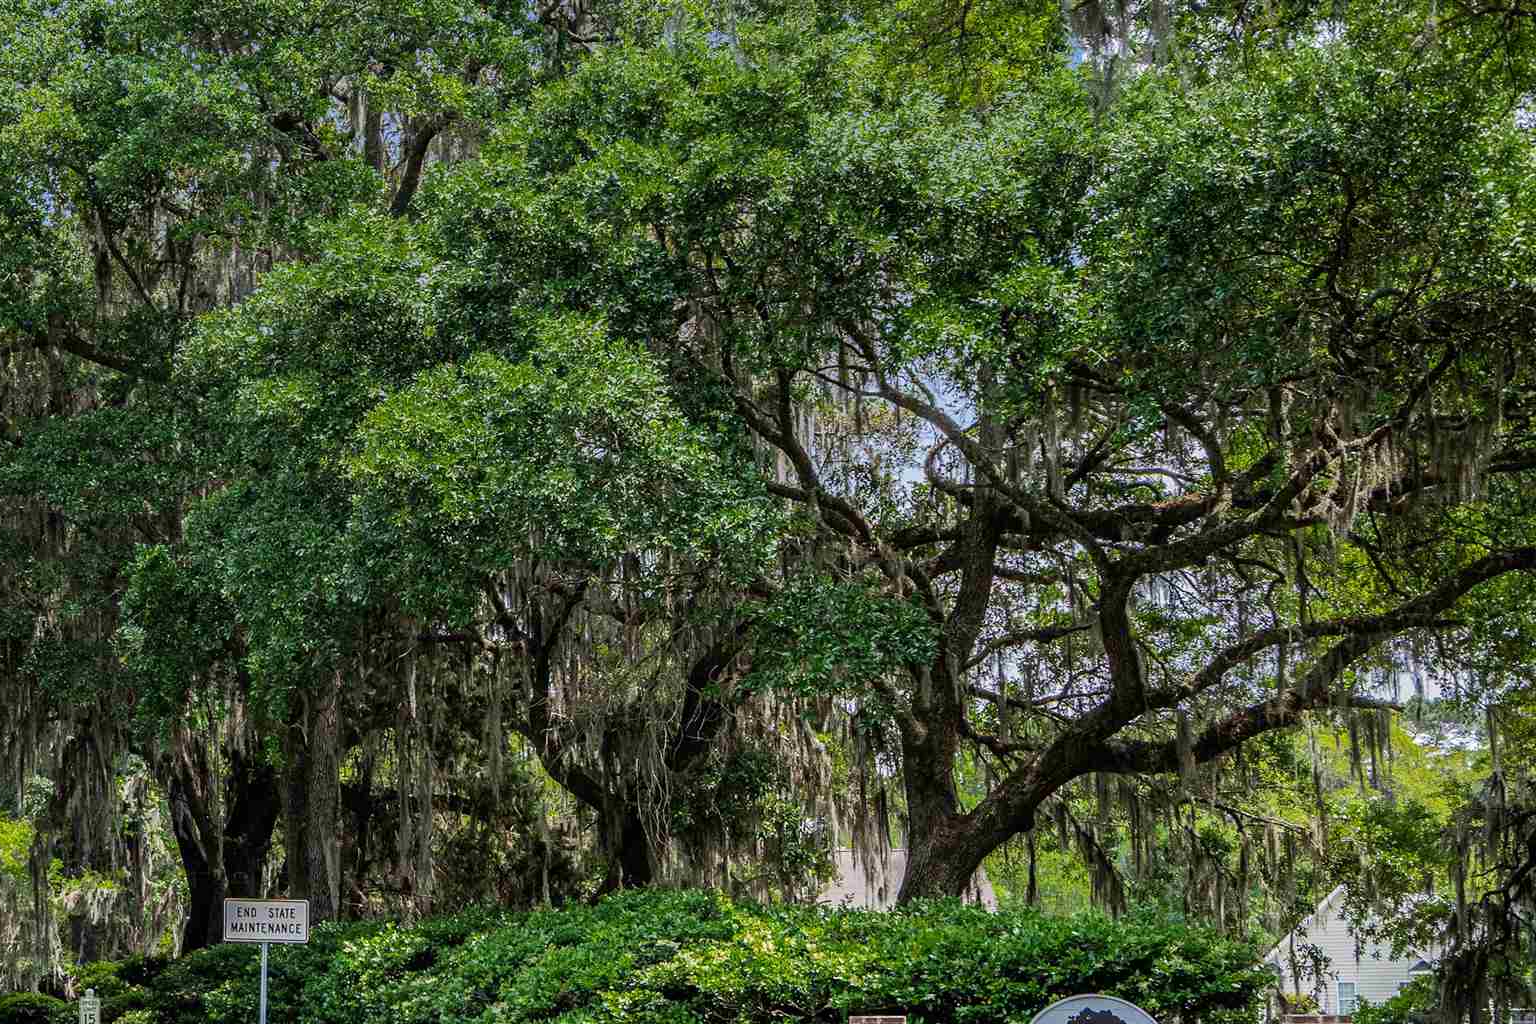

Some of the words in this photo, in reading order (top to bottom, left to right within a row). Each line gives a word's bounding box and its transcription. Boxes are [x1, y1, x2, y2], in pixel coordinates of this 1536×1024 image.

[237, 906, 257, 918] END
[268, 907, 296, 919] STATE
[231, 922, 302, 934] MAINTENANCE
[84, 1013, 96, 1024] 15
